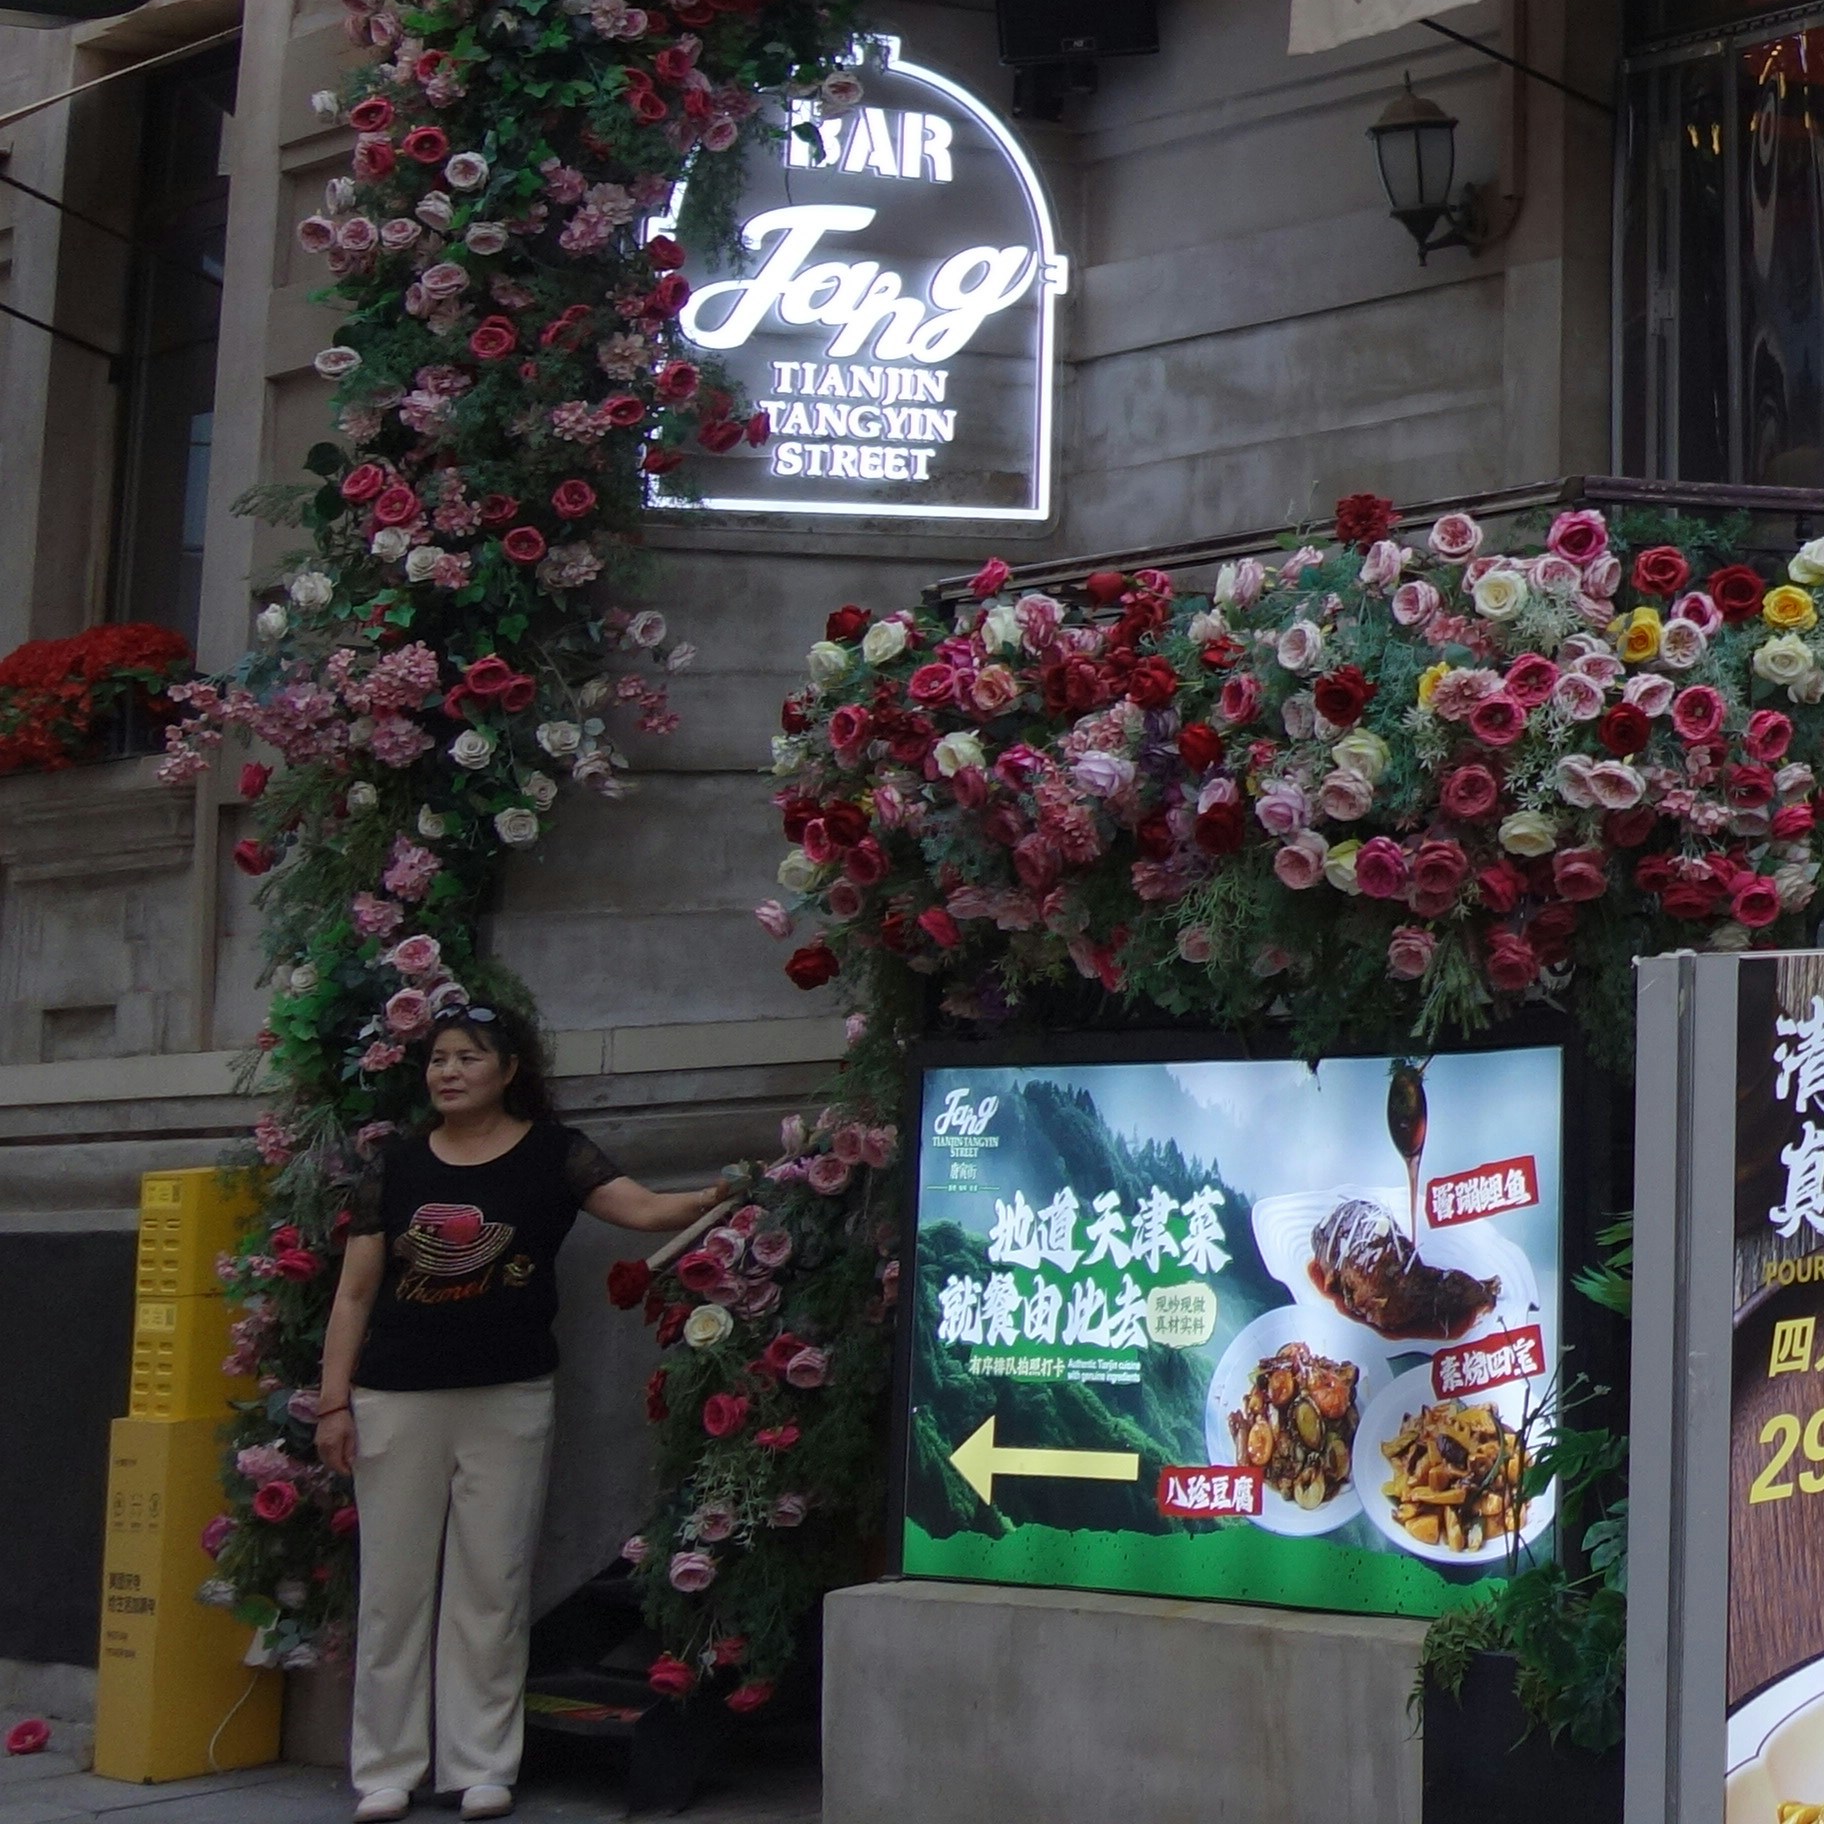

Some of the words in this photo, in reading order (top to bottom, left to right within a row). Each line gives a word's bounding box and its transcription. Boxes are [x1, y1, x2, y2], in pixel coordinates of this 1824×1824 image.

[786, 98, 953, 183] BAR
[679, 204, 1038, 364] Tang
[771, 361, 949, 405] TIANJIN
[758, 399, 957, 443] TANGYIN
[772, 442, 936, 481] STREET
[934, 1087, 1000, 1136] Tang
[987, 1184, 1233, 1275] 地道天津菜
[937, 1270, 1149, 1351] 就餐由此去
[1154, 1315, 1206, 1335] 真材实料
[968, 1355, 1066, 1378] 有序排队拍照打卡
[1164, 1474, 1254, 1513] 八珍豆腐
